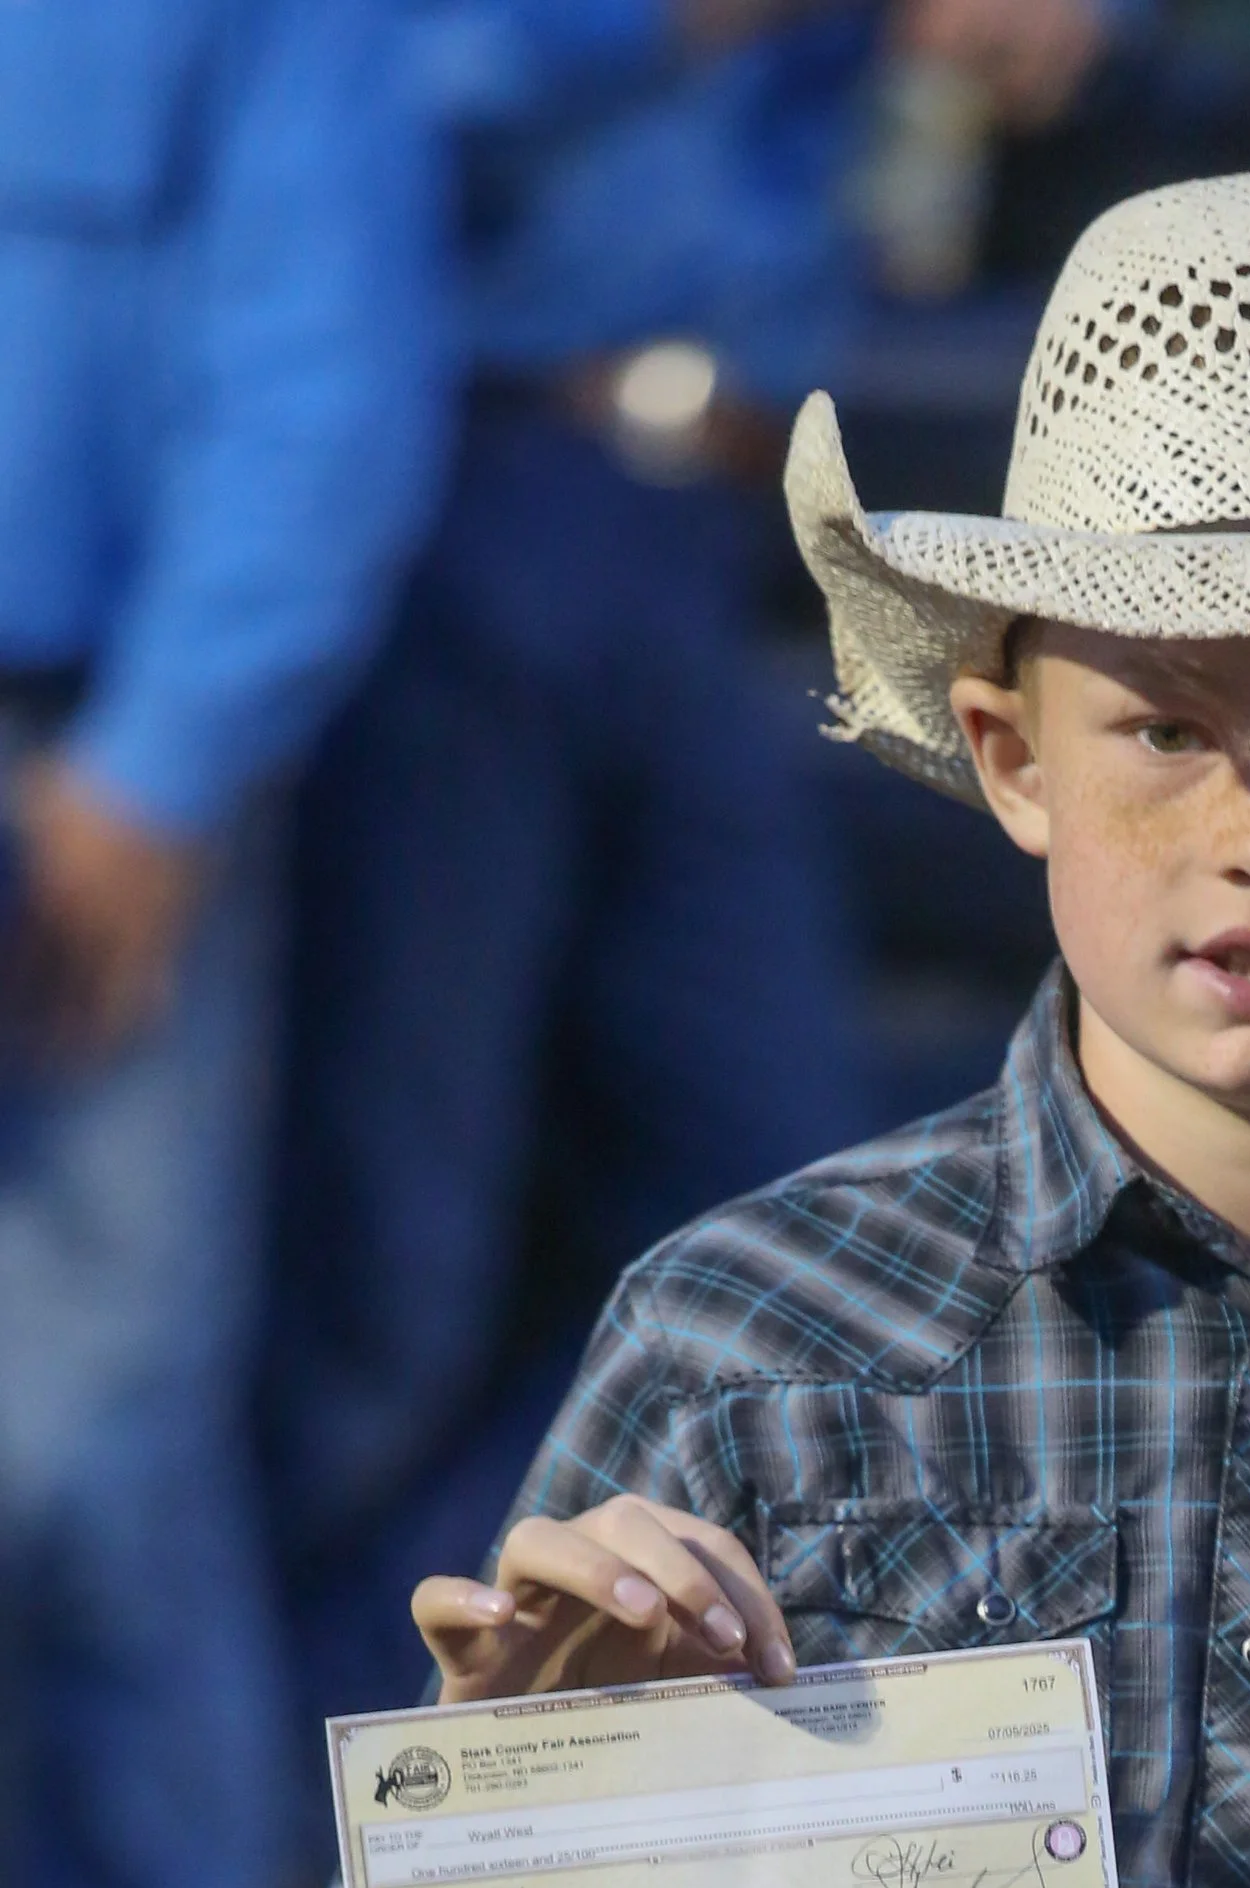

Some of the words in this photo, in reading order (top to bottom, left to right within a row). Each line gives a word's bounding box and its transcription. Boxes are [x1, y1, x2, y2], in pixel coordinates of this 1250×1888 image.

[1023, 1675, 1055, 1693] 1767
[461, 1748, 491, 1758] Stark
[496, 1742, 538, 1756] County
[542, 1738, 564, 1750] Fair
[569, 1730, 640, 1747] Association
[468, 1829, 502, 1843] Wyatt
[504, 1825, 534, 1839] West
[411, 1867, 436, 1879] One
[438, 1862, 486, 1876] hundred
[532, 1853, 554, 1866] and
